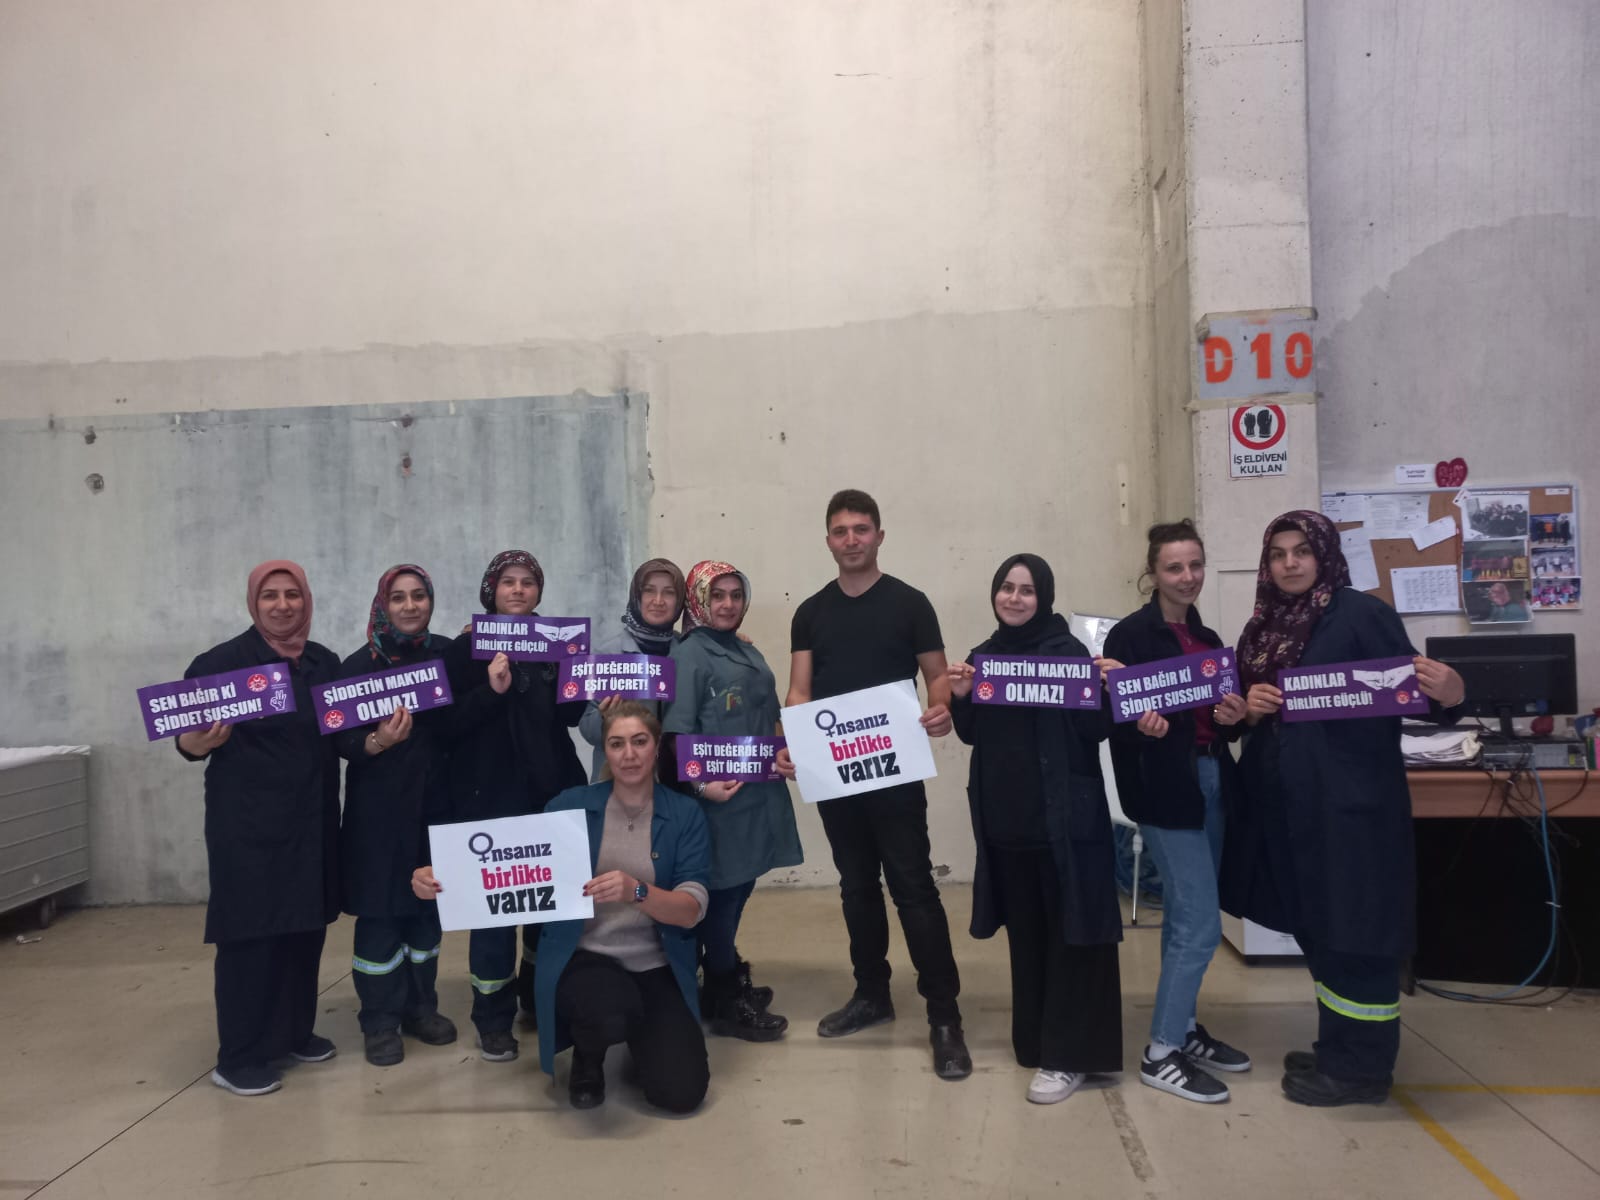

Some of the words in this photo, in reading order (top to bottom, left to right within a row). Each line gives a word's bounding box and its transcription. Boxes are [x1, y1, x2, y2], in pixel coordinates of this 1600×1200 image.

[1234, 454, 1242, 465] İŞ
[1244, 451, 1287, 463] ELDİVENİ
[1240, 464, 1282, 474] KULLAN
[476, 621, 528, 635] KADINLAR
[476, 639, 513, 651] BİRLİKTE
[514, 640, 548, 653] GÜÇLÜ!
[572, 662, 593, 678] EŞİT
[596, 661, 643, 675] DEĞERDE
[645, 662, 661, 677] İŞE
[982, 659, 1035, 678] ŞİDDETİN
[1038, 663, 1091, 679] MAKYAJI
[323, 678, 384, 706] ŞİDDETİN
[385, 667, 438, 690] MAKYAJI
[584, 678, 607, 693] EŞİT
[610, 677, 648, 691] ÜCRET!
[1117, 679, 1142, 696] SEN
[1143, 671, 1178, 691] BAĞIR
[1179, 666, 1192, 683] Kİ
[1284, 672, 1347, 692] KADINLAR
[149, 696, 177, 713] SEN
[178, 687, 220, 707] BAĞIR
[221, 682, 236, 699] Kİ
[1005, 683, 1064, 704] OLMAZ!
[1120, 694, 1162, 718] ŞİDDET
[1164, 684, 1213, 707] SUSSUN!
[1286, 693, 1332, 711] BİRLİKTE
[1333, 690, 1373, 708] GÜÇLÜ!
[154, 710, 202, 735] ŞİDDET
[204, 698, 262, 723] SUSSUN!
[356, 691, 419, 721] OLMAZ!
[693, 742, 712, 758] EŞİT
[714, 743, 757, 756] DEĞERDE
[760, 743, 774, 759] İŞE
[829, 734, 892, 762] birlikte
[706, 760, 724, 775] EŞİT
[726, 760, 762, 773] ÜCRET!
[837, 752, 900, 785] varız
[481, 864, 552, 890] birlikte
[486, 885, 556, 915] varız
